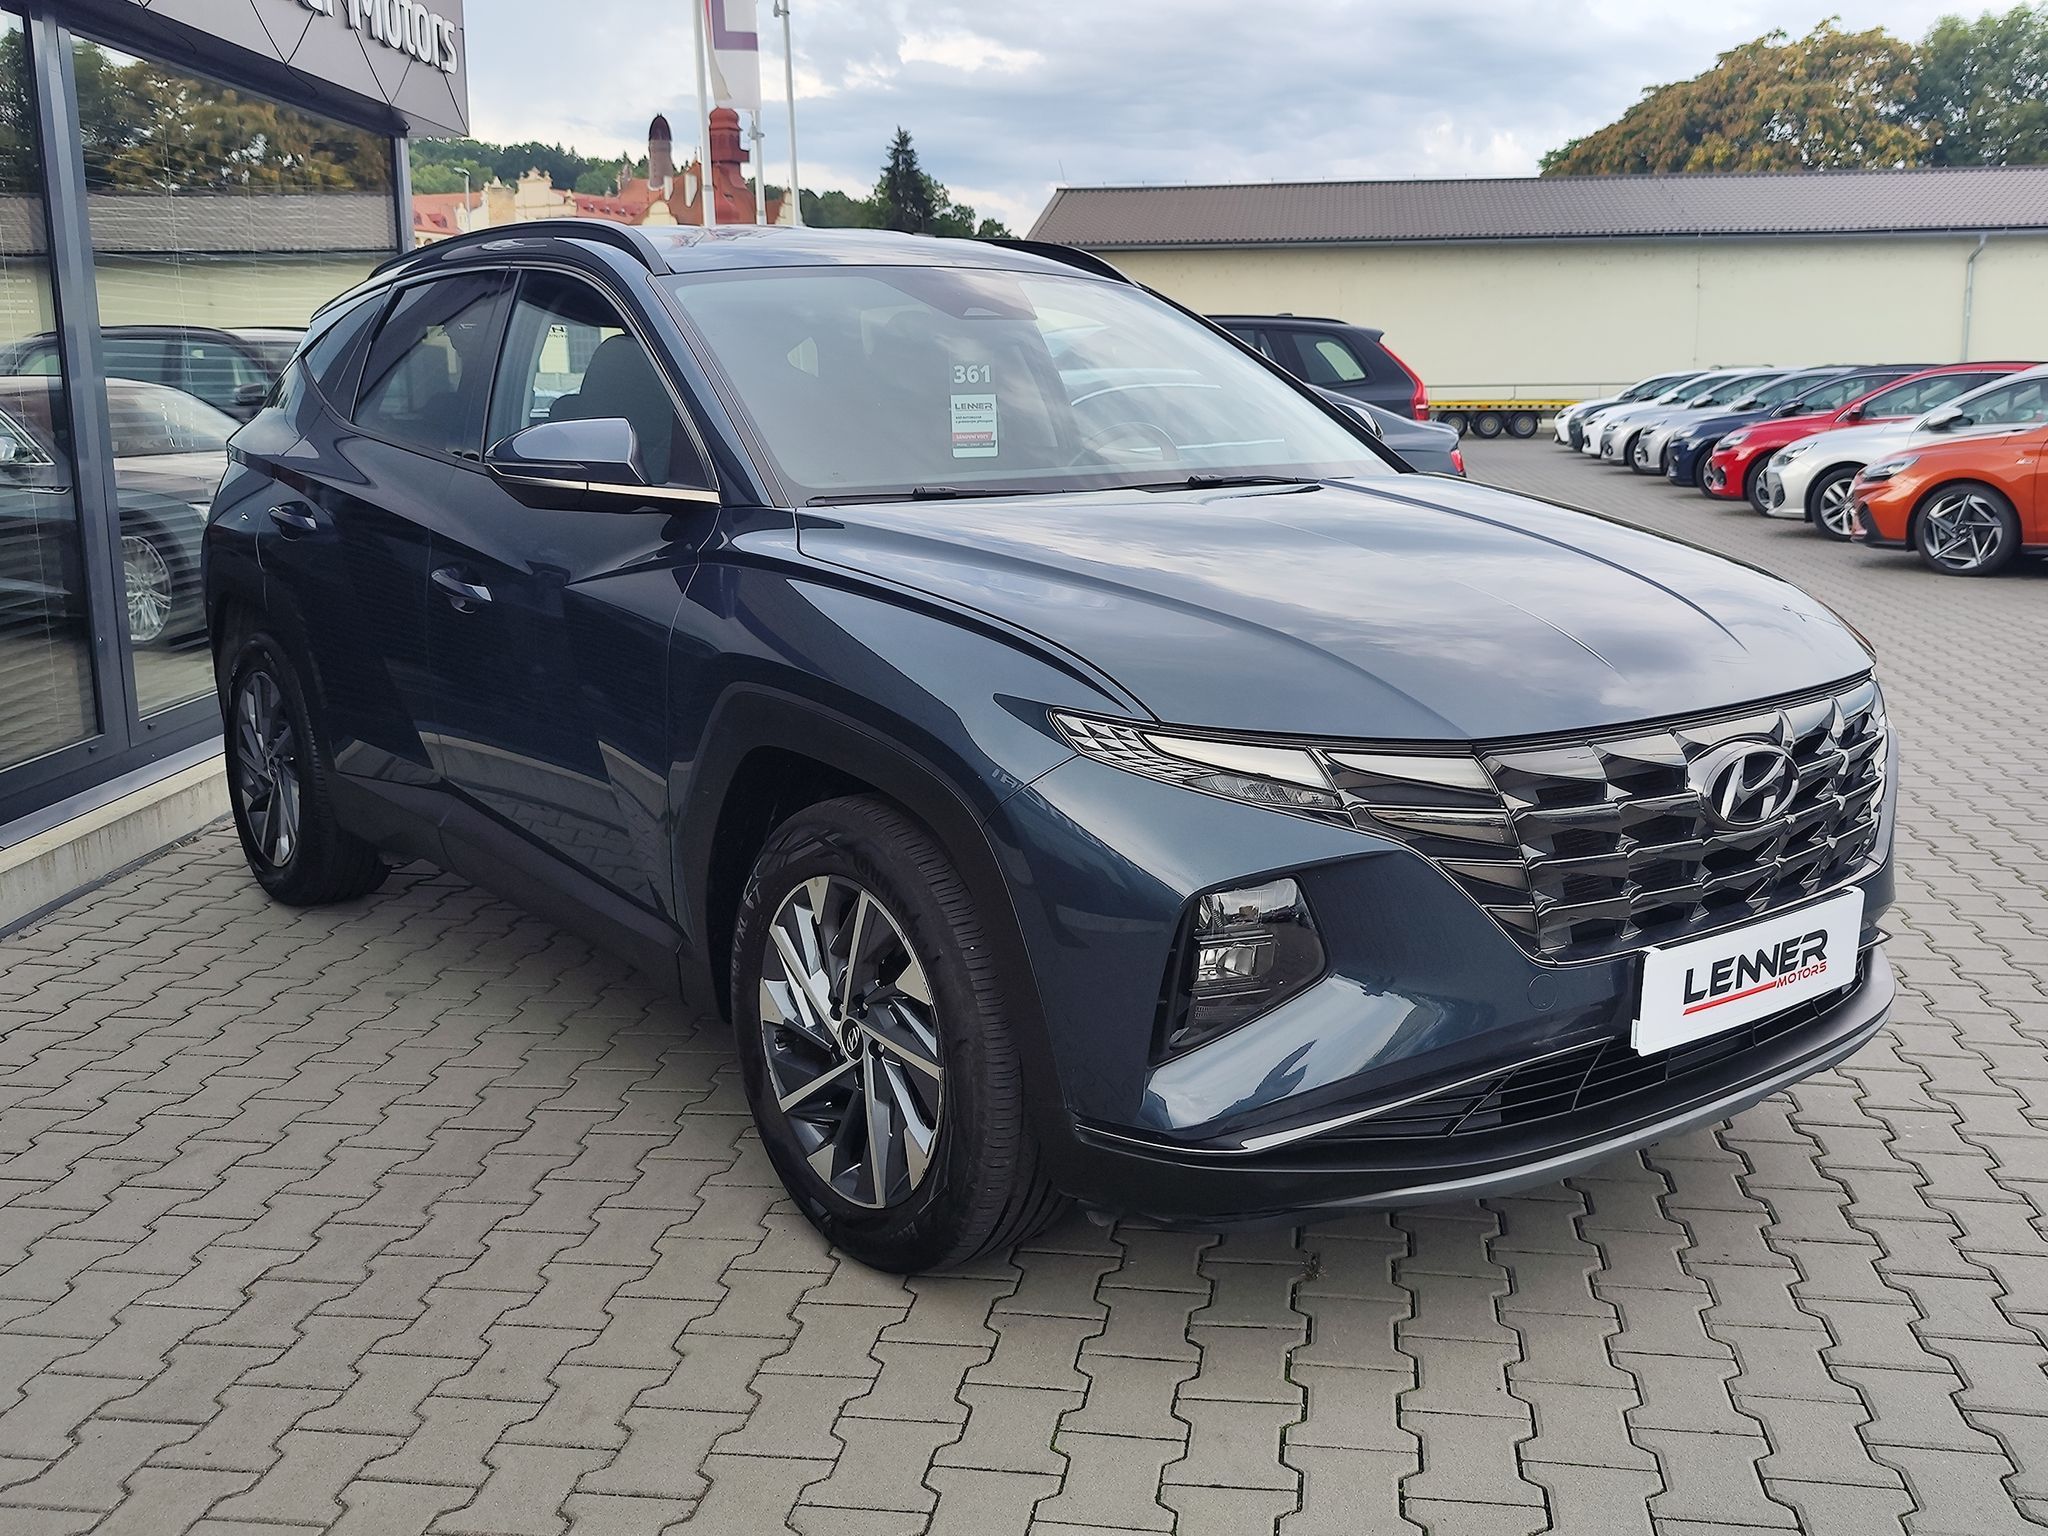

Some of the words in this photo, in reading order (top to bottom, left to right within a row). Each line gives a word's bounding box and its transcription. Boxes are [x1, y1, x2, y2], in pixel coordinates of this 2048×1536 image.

[348, 0, 458, 74] Motors
[953, 364, 991, 384] 361
[954, 402, 993, 410] LENNER
[1683, 929, 1828, 1005] LENNER
[1776, 961, 1827, 988] MOTORS
